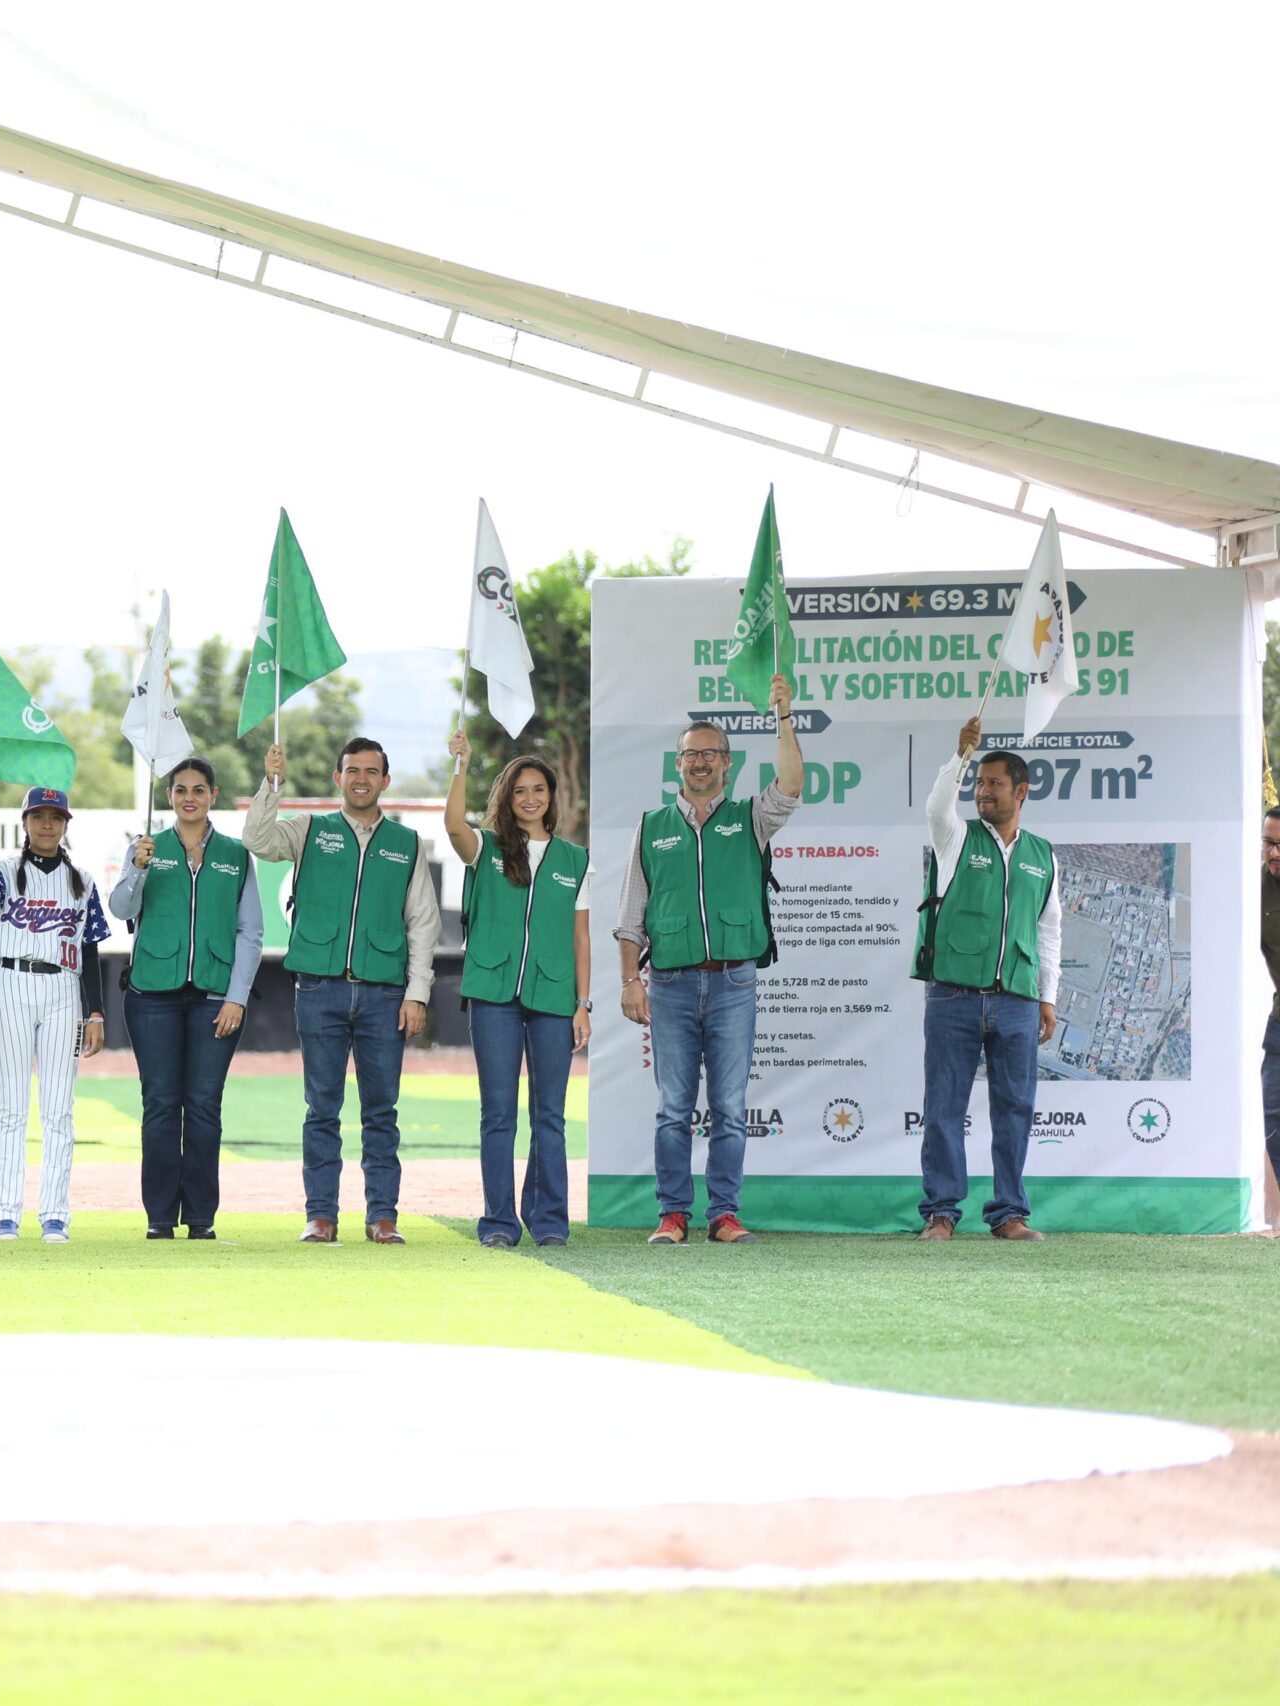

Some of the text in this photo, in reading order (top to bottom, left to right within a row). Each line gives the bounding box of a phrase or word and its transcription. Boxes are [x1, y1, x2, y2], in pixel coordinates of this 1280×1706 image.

[786, 587, 900, 614] VERSIÓN
[930, 588, 989, 611] 69.3
[694, 629, 923, 665] RELITACIÓN
[929, 634, 981, 661] DEL
[1097, 631, 1134, 658] DE
[820, 674, 839, 701] Y
[844, 671, 972, 700] SOFTBOL
[1097, 668, 1130, 696] 91
[1075, 735, 1121, 747] TOTAL
[770, 846, 880, 858] OS TRABAJOS:
[780, 884, 853, 892] atural mediante
[782, 897, 899, 907] homogenizado, tendido y
[777, 912, 813, 921] espesor
[816, 911, 827, 919] de
[830, 911, 840, 919] 15
[806, 924, 862, 934] compactada
[865, 924, 873, 932] al
[875, 923, 899, 932] 90%.
[779, 937, 900, 948] riego de liga con emulsión
[60, 941, 77, 970] 10
[768, 978, 780, 986] de
[782, 978, 809, 987] 5,728
[810, 978, 826, 986] m2
[828, 978, 840, 986] de
[842, 978, 868, 988] pasto
[763, 992, 799, 1000] caucho.
[768, 1005, 780, 1013] de
[783, 1004, 808, 1013] tierra
[810, 1005, 828, 1015] roja
[844, 1004, 872, 1014] 3,569
[874, 1004, 892, 1013] m2.
[770, 1033, 776, 1041] y
[778, 1031, 816, 1040] casetas.
[753, 1045, 787, 1054] quetas.
[773, 1058, 805, 1067] bardas
[807, 1058, 867, 1068] perimetrales,
[834, 1098, 859, 1108] PASOS
[1033, 1112, 1086, 1126] EJORA
[832, 1124, 864, 1142] GIGANTE
